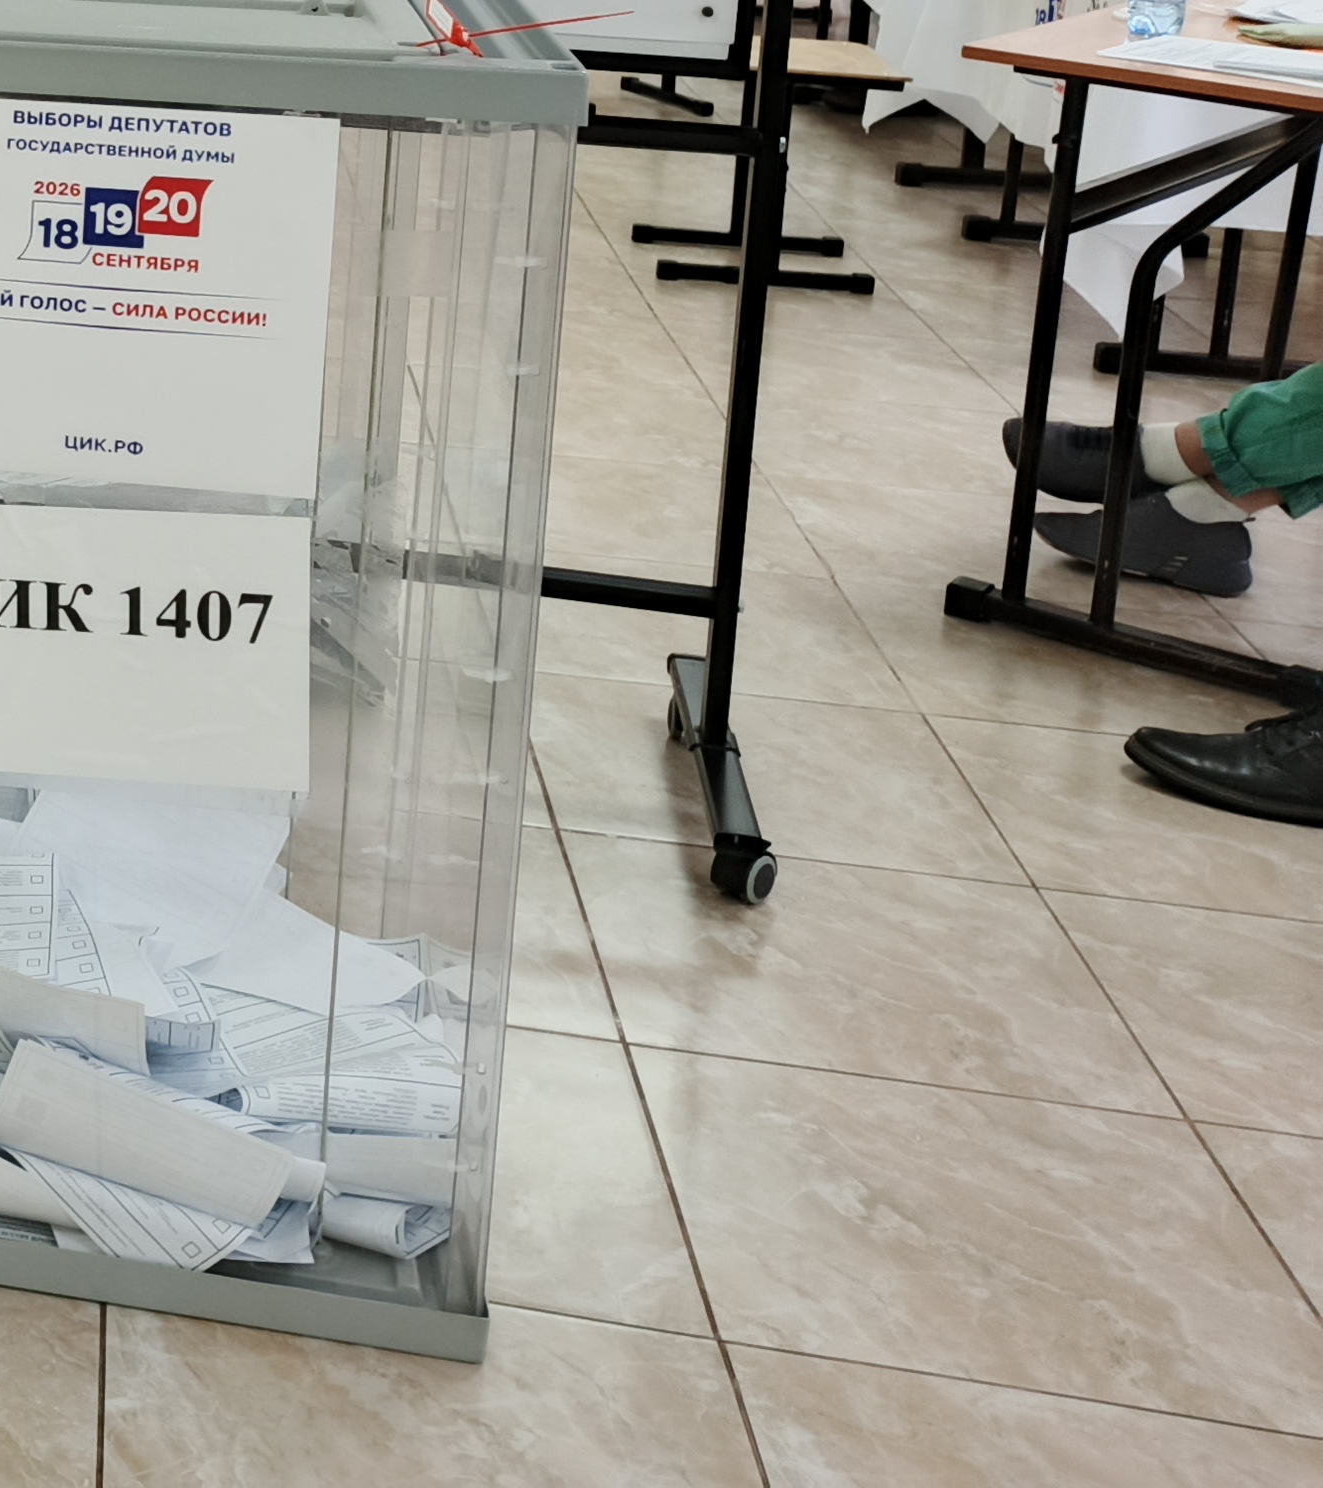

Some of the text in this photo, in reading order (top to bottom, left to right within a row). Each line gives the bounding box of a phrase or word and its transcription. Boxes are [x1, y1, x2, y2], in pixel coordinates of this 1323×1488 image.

[13, 110, 232, 137] ВЫБОРЫ ДЕПУТАТОВ
[7, 138, 235, 164] ГОСУДАРСТВЕННОЙ ДУМЫ
[33, 180, 81, 197] 2026
[38, 189, 198, 250] 18 19 20
[91, 252, 199, 273] СЕНТЯБРЯ
[20, 295, 87, 314] ГОЛОС
[111, 302, 169, 320] СИЛА
[174, 307, 267, 327] РОССИИ!
[64, 434, 144, 456] ЦИК.РФ
[119, 585, 273, 645] 1407
